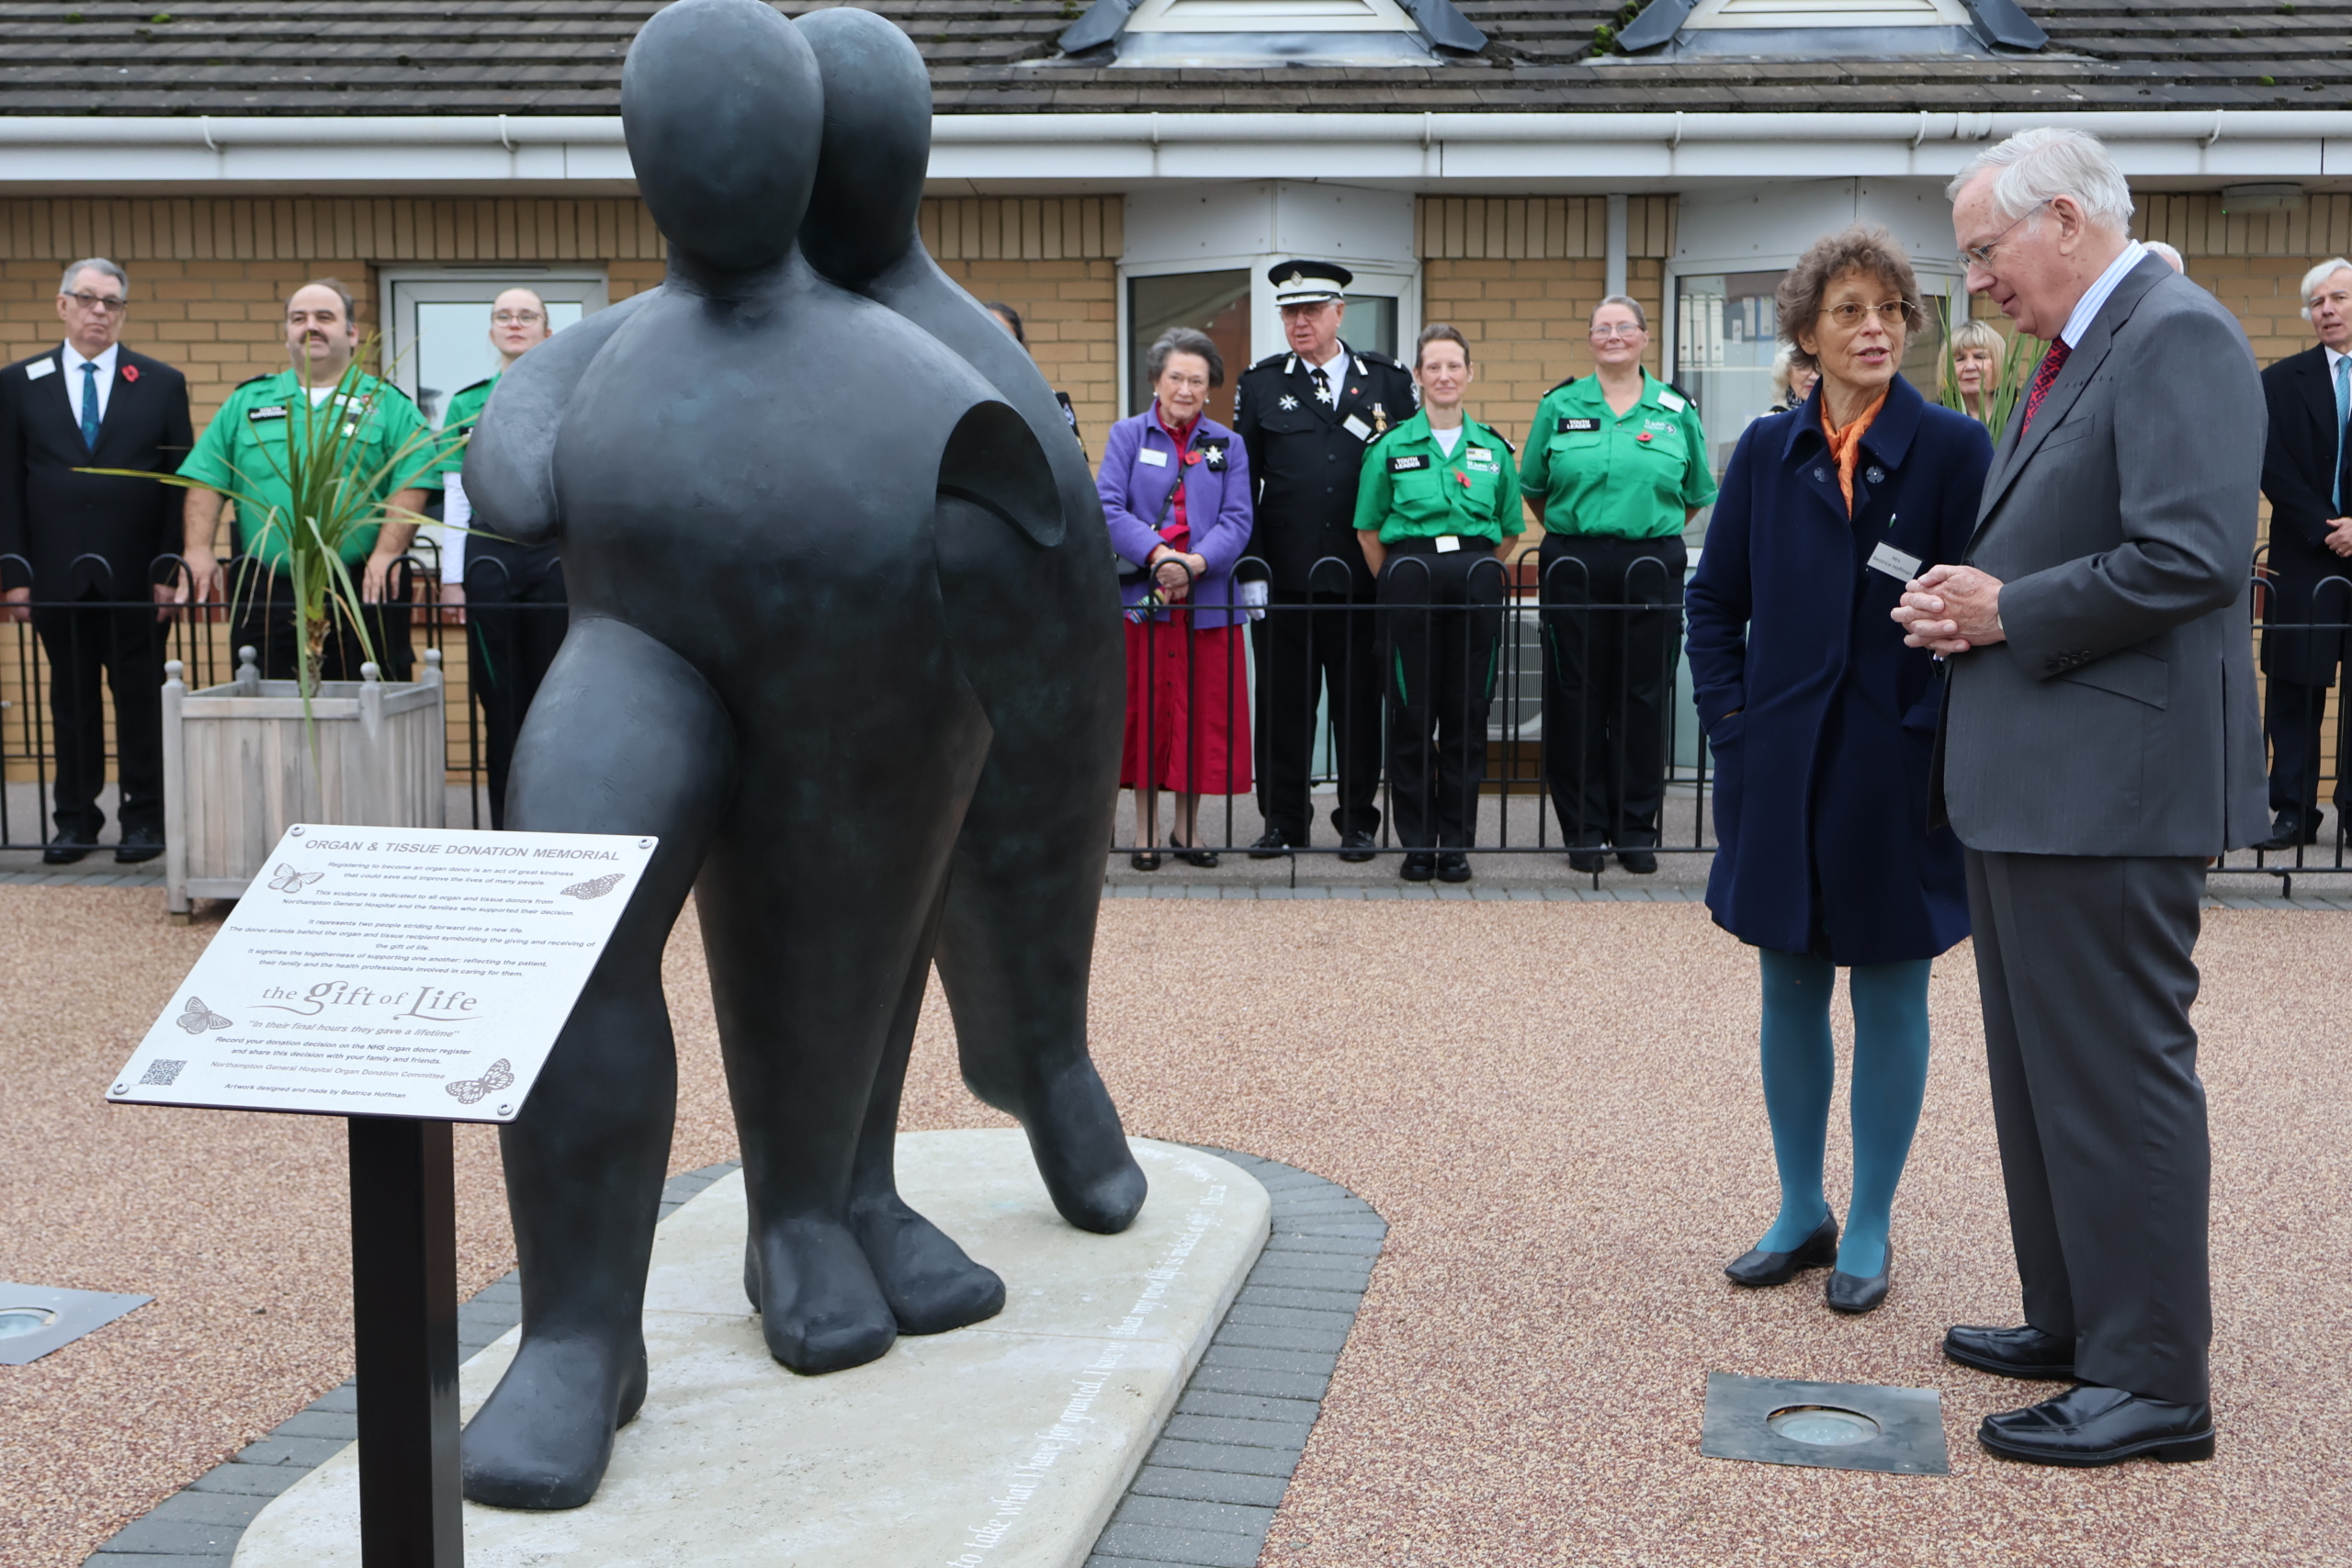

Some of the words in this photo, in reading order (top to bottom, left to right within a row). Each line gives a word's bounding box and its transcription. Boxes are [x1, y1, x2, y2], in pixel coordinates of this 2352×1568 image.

[1395, 460, 1420, 469] LEADER
[1396, 456, 1419, 464] YOUTH
[305, 840, 364, 851] ORGAN
[367, 842, 379, 852] &
[386, 842, 442, 853] TISSUE
[445, 845, 529, 857] DONATION
[533, 848, 619, 861] MEMORIAL
[327, 862, 370, 870] Registering
[463, 958, 502, 966] reflecting
[262, 986, 298, 1000] the
[301, 980, 378, 1016] gift
[379, 992, 409, 1006] of
[393, 986, 478, 1021] Life
[291, 1022, 317, 1031] final
[316, 1023, 348, 1032] hours
[350, 1026, 375, 1035] they
[366, 1055, 391, 1063] family
[411, 1056, 441, 1065] friends.
[210, 1061, 264, 1069] Northampton
[334, 1067, 360, 1076] Organ
[361, 1068, 399, 1077] Donation
[401, 1071, 446, 1079] Committee
